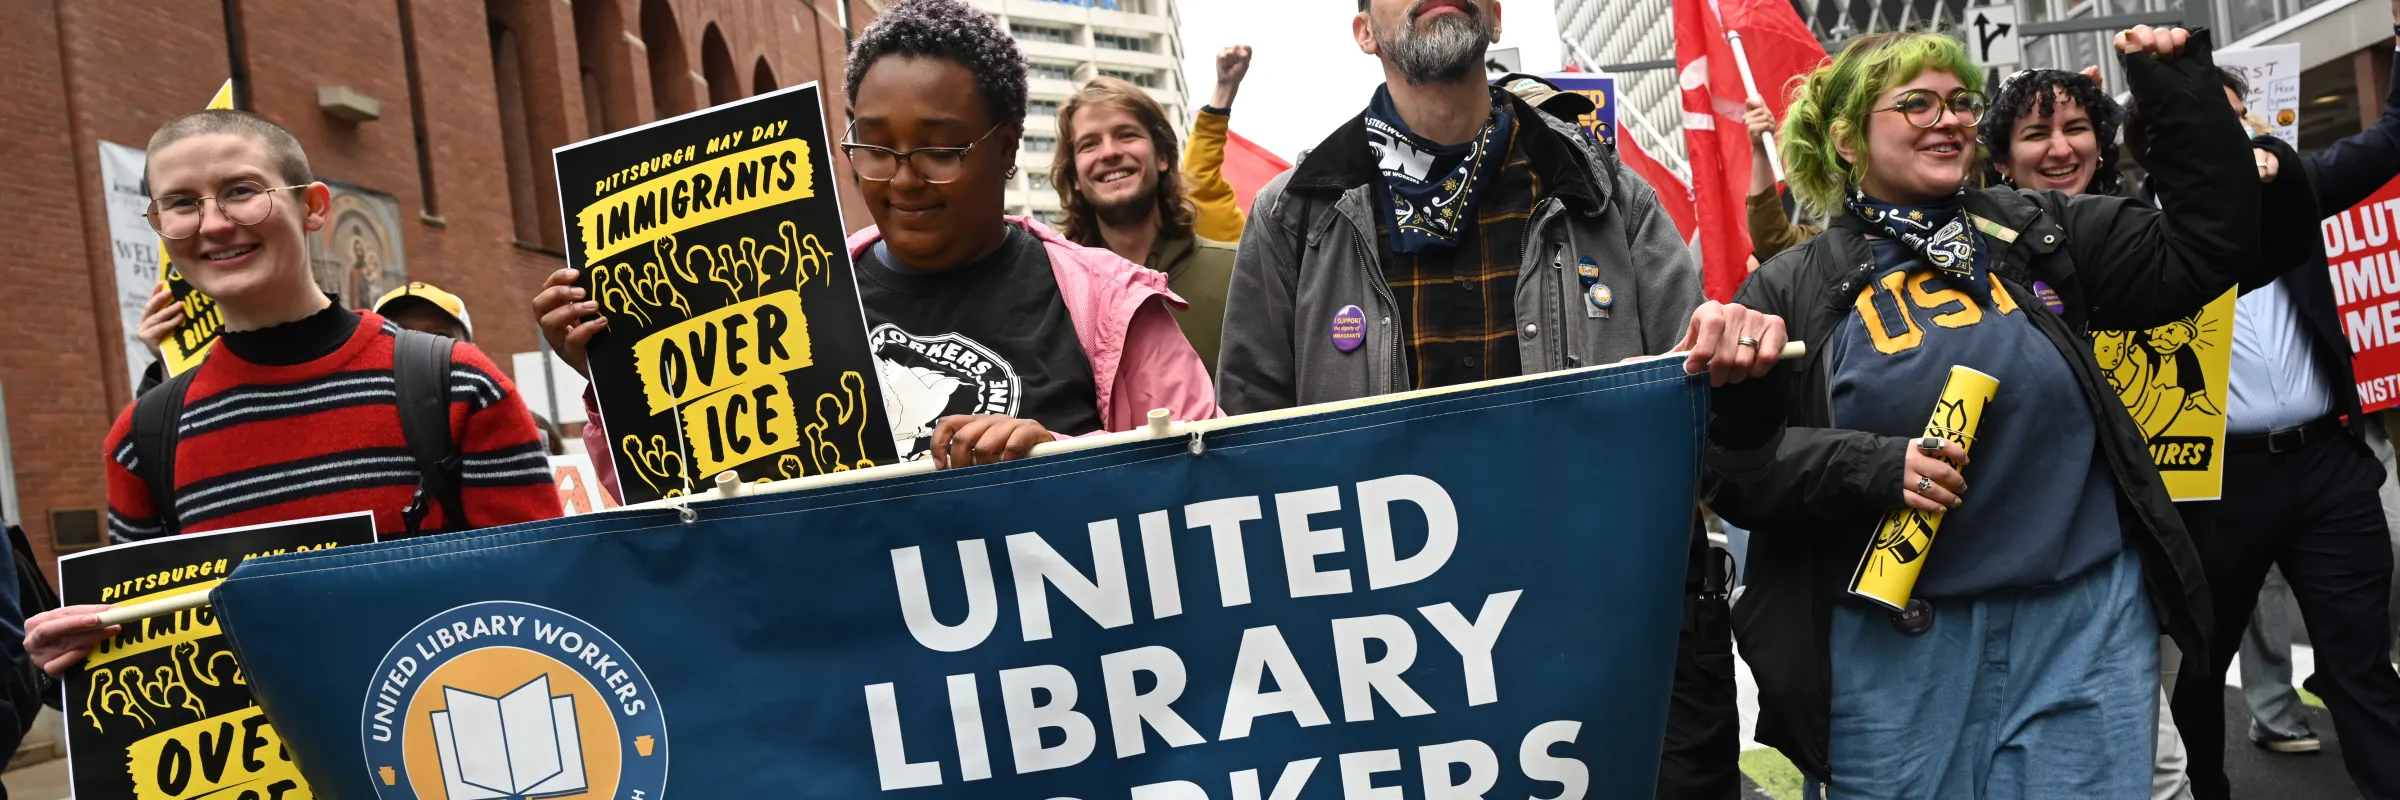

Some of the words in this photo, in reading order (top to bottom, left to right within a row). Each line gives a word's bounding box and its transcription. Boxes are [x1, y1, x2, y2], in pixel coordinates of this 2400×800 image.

[595, 145, 696, 197] PITTSBURGH
[706, 130, 743, 155] MAY
[752, 119, 788, 142] DAY
[596, 150, 797, 251] IMMIGRANTS
[659, 303, 790, 399] OVER
[870, 329, 993, 376] WORKERS
[1337, 317, 1362, 325] SUPPORT
[2342, 300, 2400, 353] ME
[706, 384, 778, 463] ICE
[983, 379, 1009, 415] INE
[2356, 374, 2400, 406] NIST
[101, 558, 228, 602] PITTSBURGH
[890, 474, 1459, 653] UNITED
[372, 655, 418, 742] UNITED
[416, 615, 526, 661] LIBRARY
[534, 618, 646, 717] WORKERS
[864, 588, 1524, 792] LIBRARY
[157, 714, 292, 797] OVE
